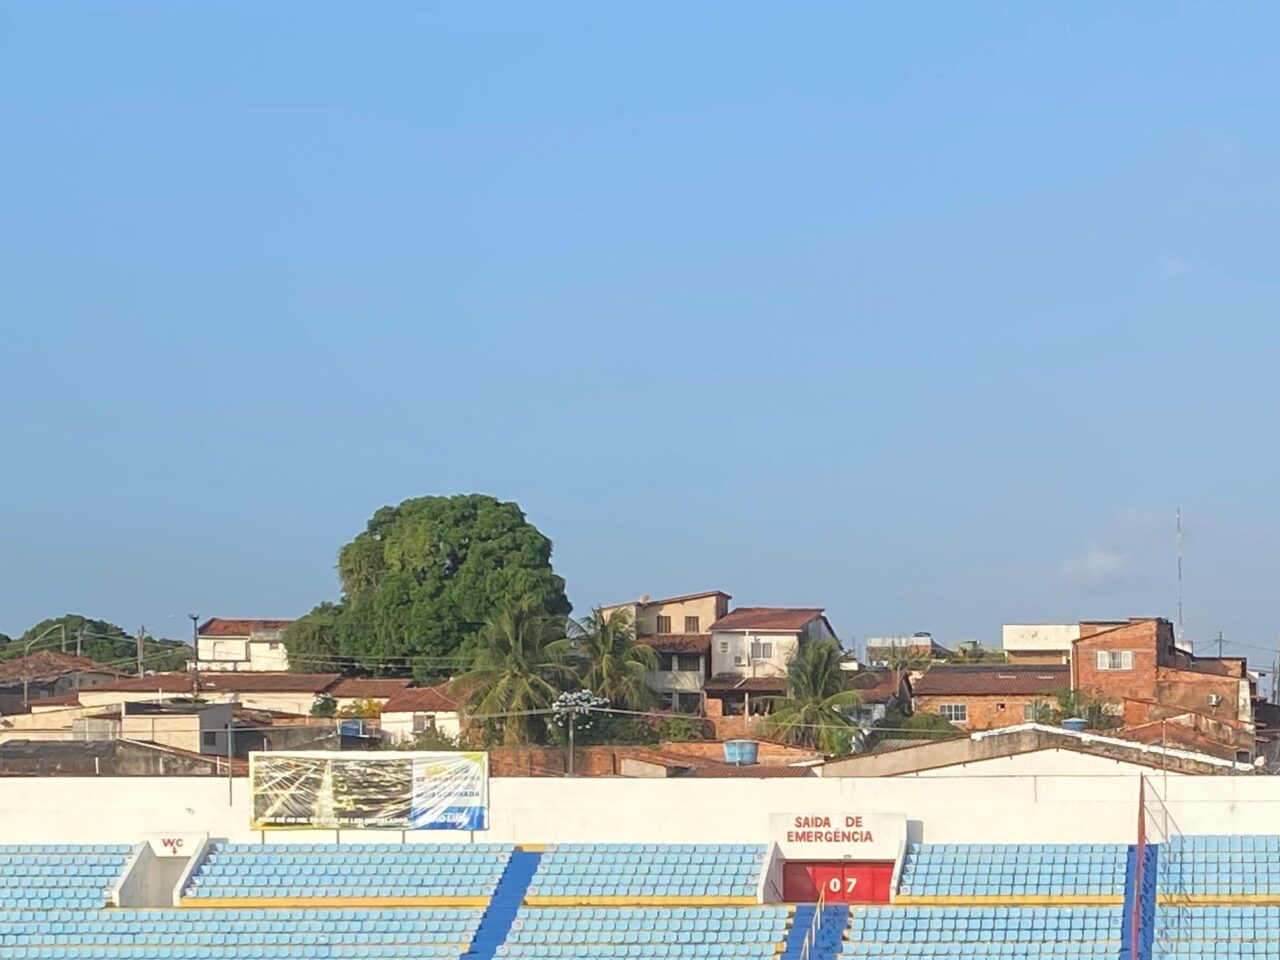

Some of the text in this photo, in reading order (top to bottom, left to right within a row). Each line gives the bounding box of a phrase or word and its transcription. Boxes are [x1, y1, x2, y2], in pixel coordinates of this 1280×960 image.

[794, 813, 863, 828] SAÍDA DE
[787, 828, 873, 842] EMERGÊNCIA
[162, 838, 183, 847] WC
[829, 878, 857, 893] 07
